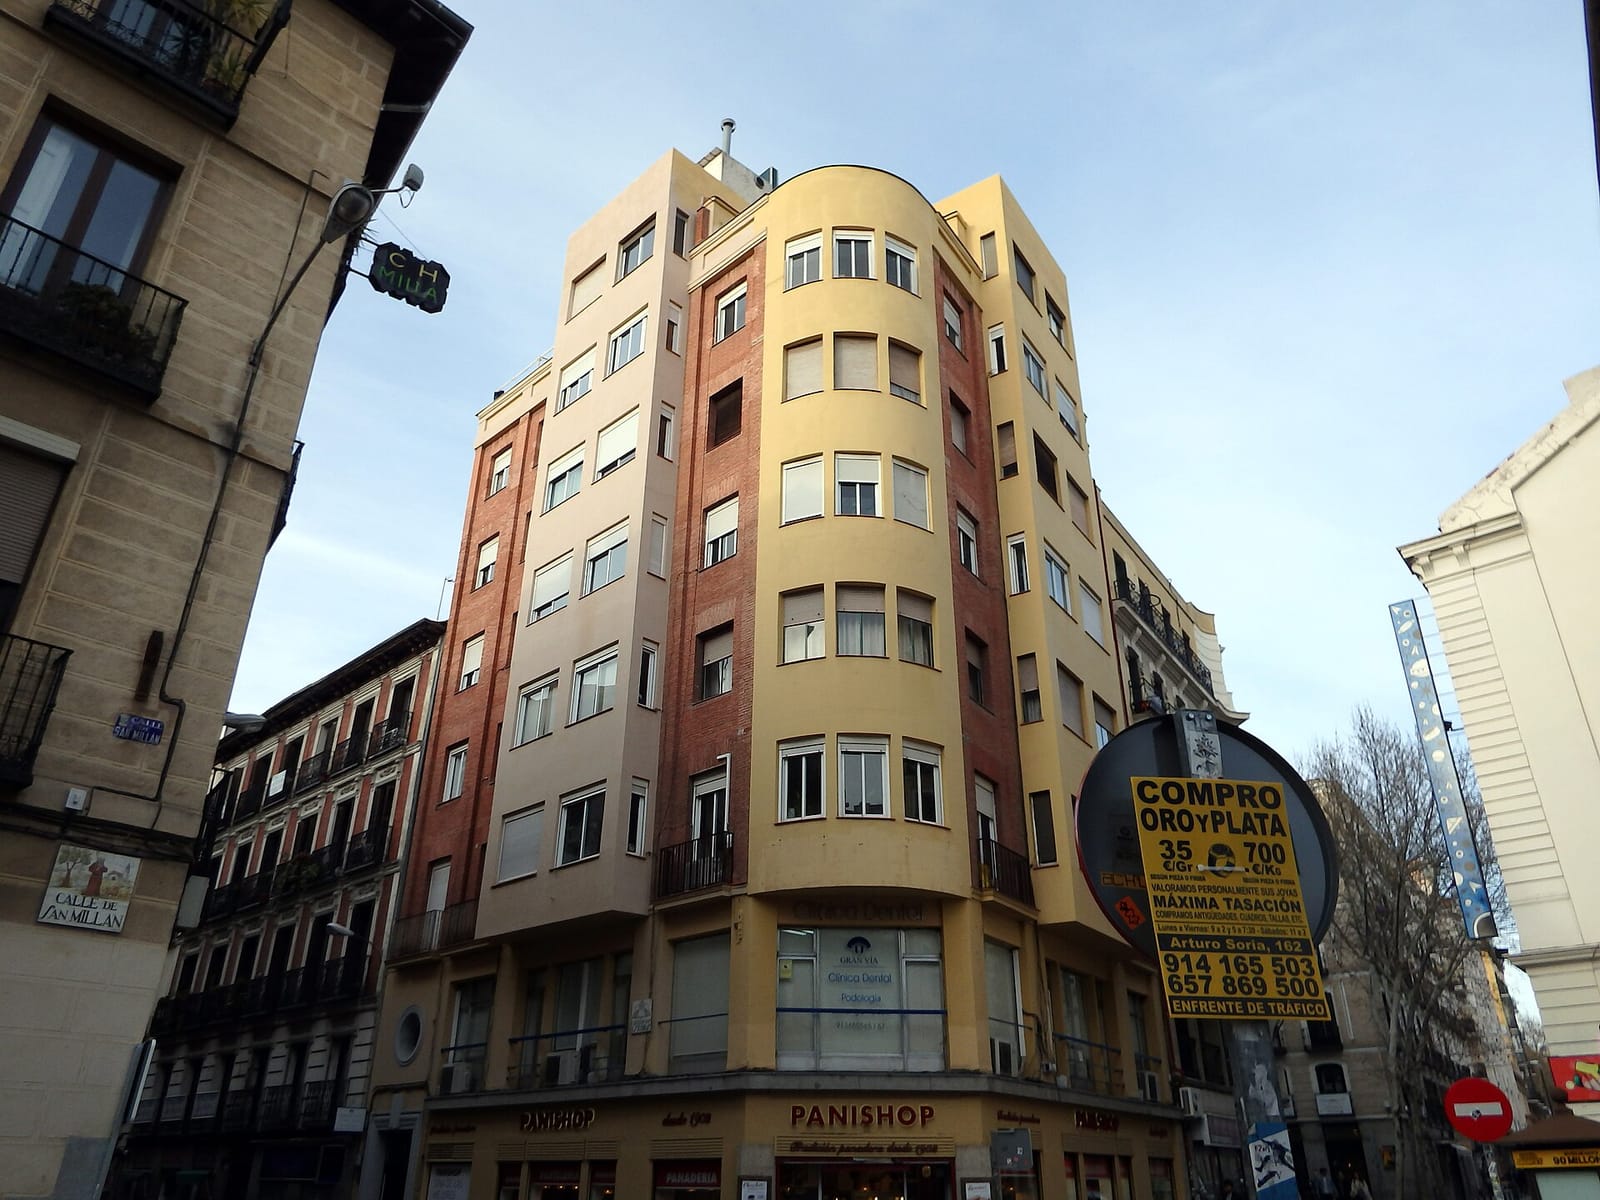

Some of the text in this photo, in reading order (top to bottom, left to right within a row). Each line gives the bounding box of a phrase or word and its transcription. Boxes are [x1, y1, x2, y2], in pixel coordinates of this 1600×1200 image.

[114, 726, 130, 737] SAN
[1137, 780, 1281, 810] COMPRO
[1141, 808, 1194, 832] ORO
[1210, 810, 1287, 837] PLATA
[1159, 840, 1286, 864] 35 700
[1152, 884, 1298, 897] VALORAMOS PERSONALMENTE SUS JOYAS
[56, 892, 117, 911] CALLE DE
[1153, 893, 1302, 913] MÁXIMA TASACIÓN
[71, 909, 123, 927] MILLAN
[1170, 937, 1221, 950] Arturo
[1275, 940, 1303, 952] 162
[840, 956, 862, 964] GRAN
[1163, 953, 1315, 977] 914 165 503
[862, 973, 892, 983] Dental
[1168, 974, 1319, 997] 657 869 500
[1173, 1000, 1244, 1014] ENFRENTE
[1247, 1002, 1265, 1014] DE
[791, 1105, 935, 1126] PANISHOP
